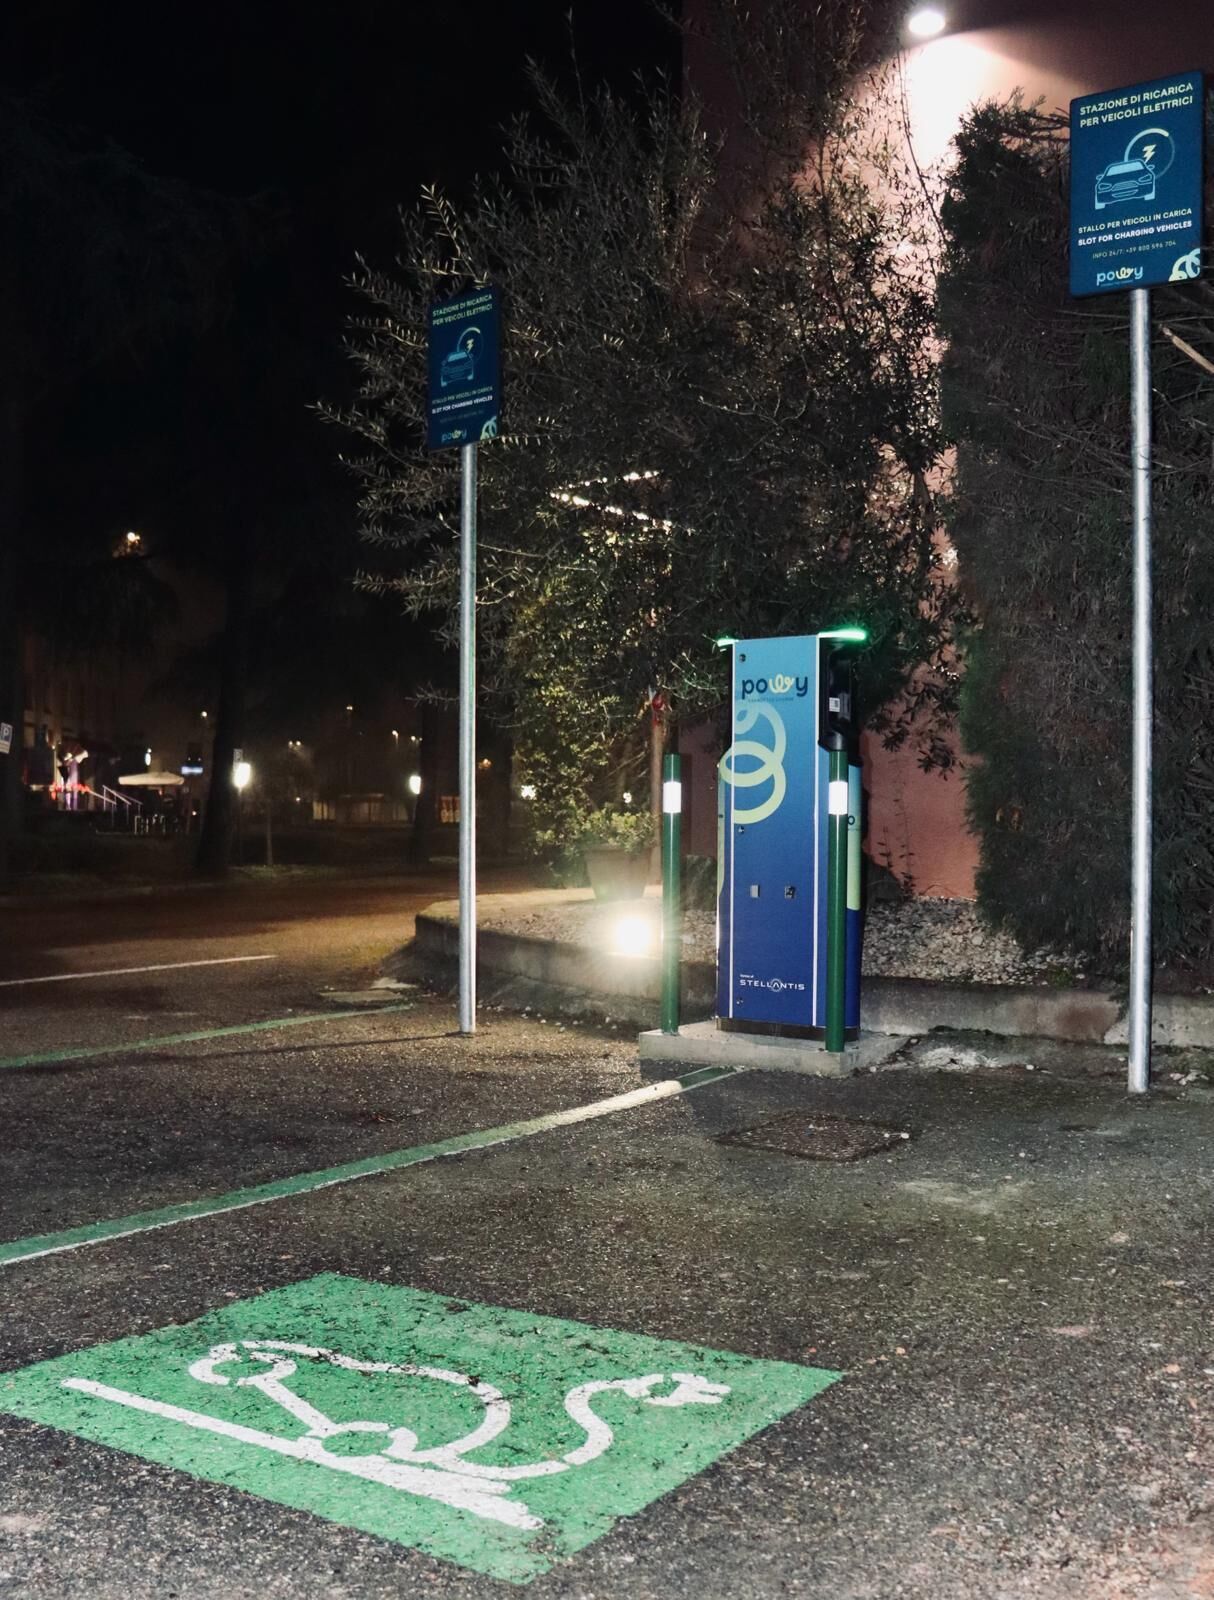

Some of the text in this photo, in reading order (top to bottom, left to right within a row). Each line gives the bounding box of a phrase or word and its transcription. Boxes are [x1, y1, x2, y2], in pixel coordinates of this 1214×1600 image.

[1080, 82, 1194, 115] STAZIONE DI RICARICA
[1080, 95, 1193, 128] PER VEICOLI ELETTRICI
[1078, 208, 1192, 234] STALLO PER VEICOLI IN CARICA
[1078, 220, 1193, 246] SLOT FOR CHARGING VEHICLES
[432, 304, 460, 317] STAZIONE
[466, 294, 492, 306] RICARICA
[432, 303, 492, 326] PER VEICOLI ELETTRICI
[739, 979, 805, 991] STELLANTIS
